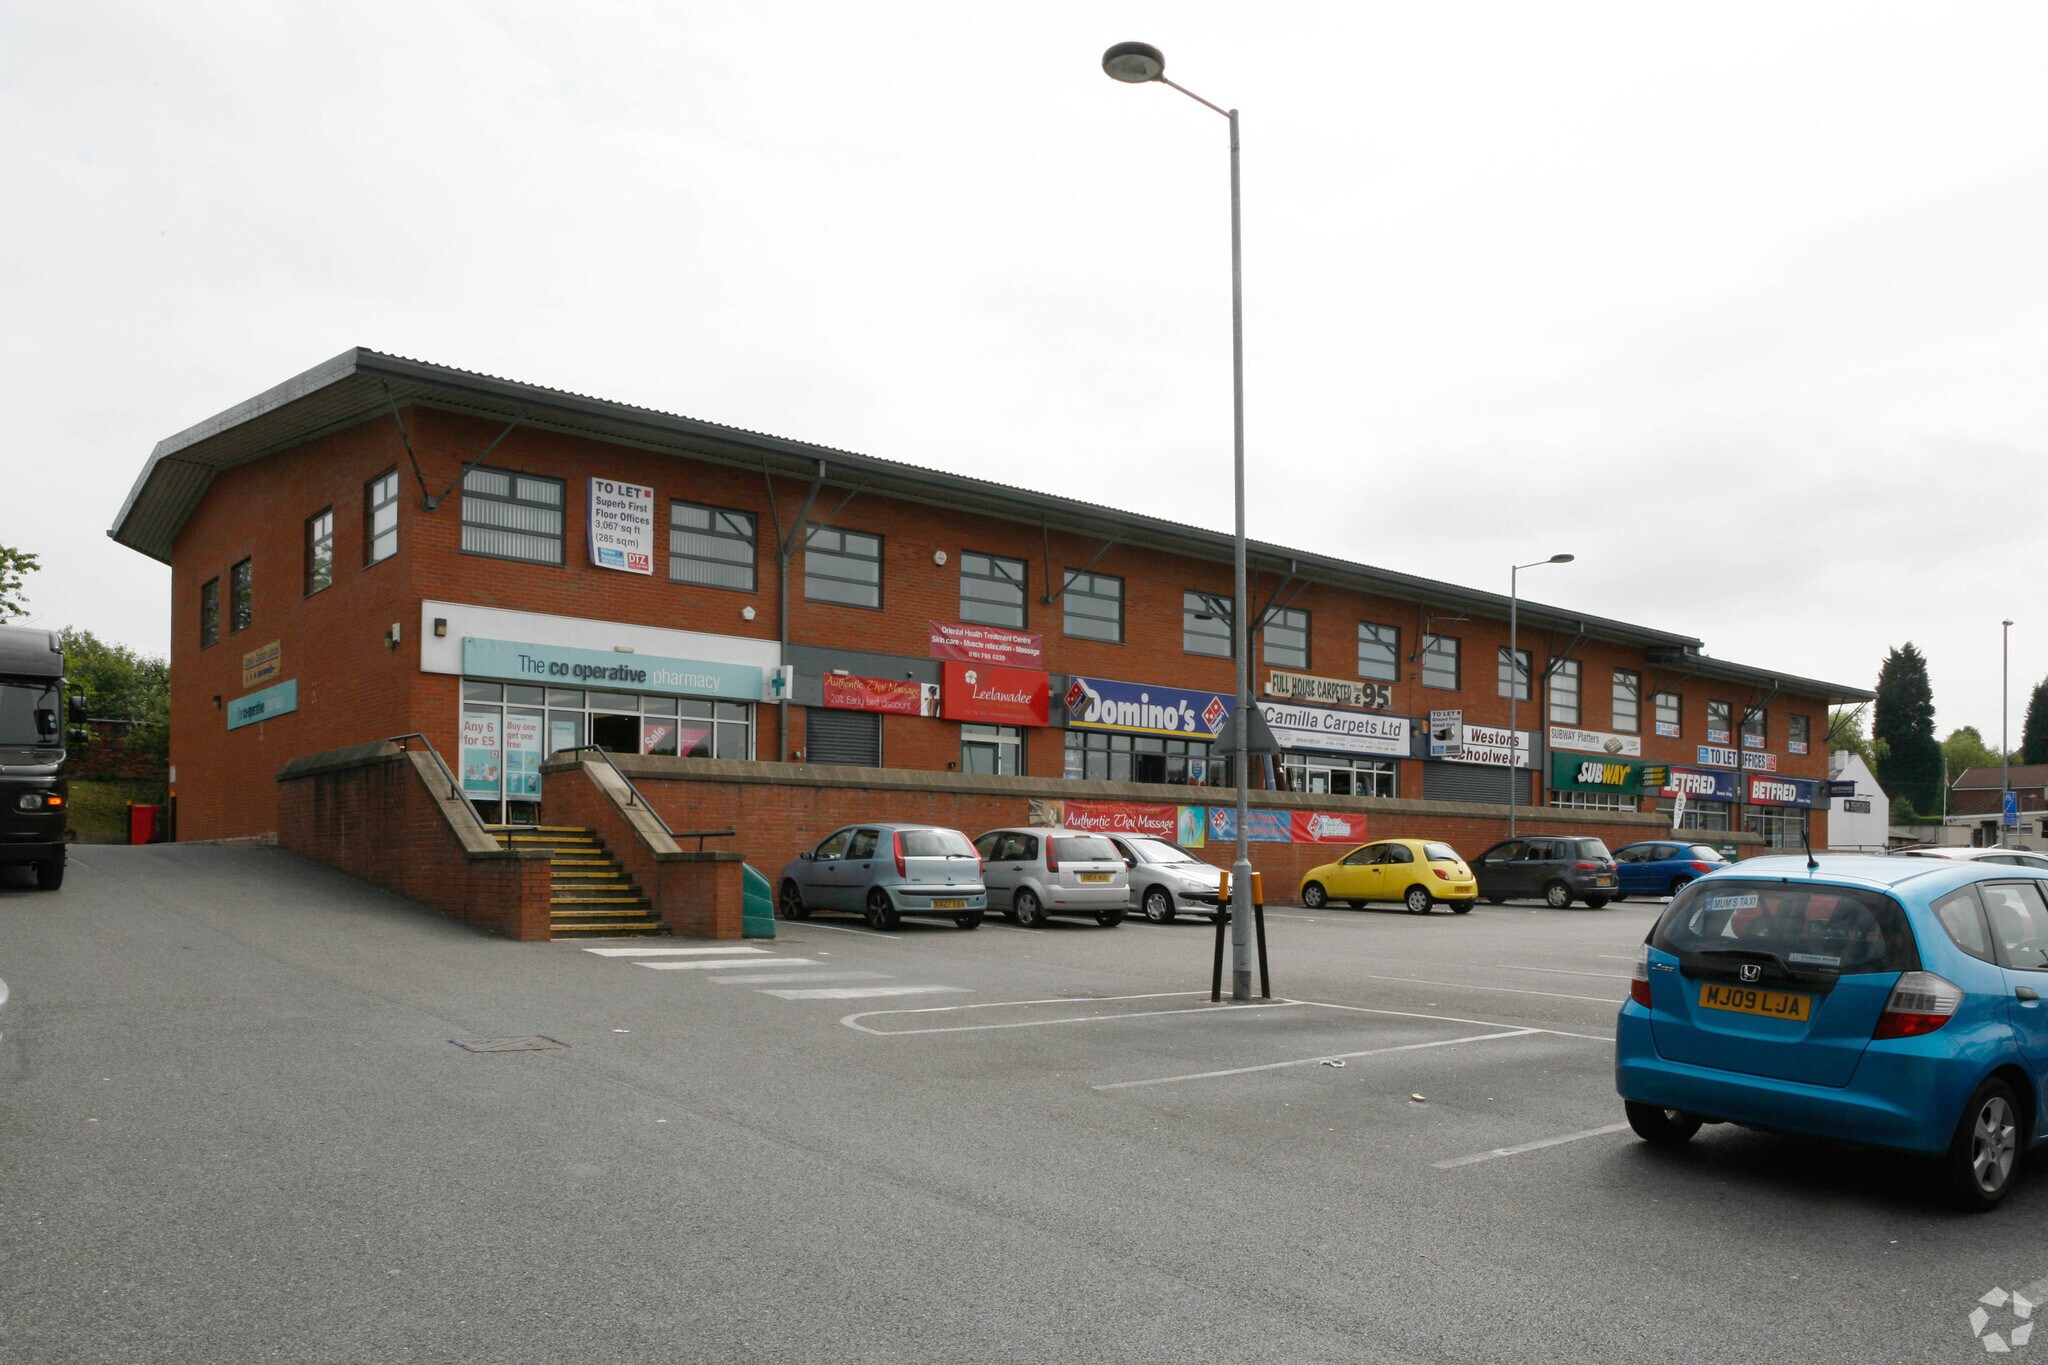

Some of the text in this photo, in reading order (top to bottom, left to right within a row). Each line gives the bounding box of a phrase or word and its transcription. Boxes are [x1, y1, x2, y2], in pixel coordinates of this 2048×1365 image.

[596, 481, 642, 498] TO LET
[596, 496, 647, 513] Superb First
[596, 508, 650, 525] Floor Offices
[595, 520, 641, 535] 3,067 sq ft
[596, 533, 614, 544] (285
[628, 553, 646, 565] DTZ
[941, 625, 1032, 645] Oriental Health Treatment Centre
[931, 635, 945, 643] Skin
[963, 639, 984, 649] Muscle
[984, 641, 1012, 651] relaxation
[1015, 646, 1040, 656] Massage
[518, 655, 721, 691] The co operative pharmacy
[825, 676, 920, 699] Authentic Thai Massage
[972, 683, 1032, 704] Leelawadee
[1272, 674, 1289, 694] FULL
[1291, 677, 1315, 698] HOUSE
[1317, 680, 1352, 700] CARPETED
[831, 694, 912, 710] 20% Early bird discount
[1076, 678, 1195, 732] Domino's
[464, 721, 494, 734] Any 6
[506, 722, 520, 732] Buy
[1264, 706, 1402, 737] Camilla Carpets Ltd
[464, 735, 495, 746] for £5
[506, 732, 519, 741] get
[506, 740, 521, 749] free
[644, 726, 666, 748] Sale
[1471, 728, 1519, 747] Westons
[1551, 728, 1599, 744] SUBWAY Platters
[1710, 748, 1721, 763] TO
[1723, 751, 1737, 766] LET
[1577, 762, 1631, 785] SUBWAY
[1752, 778, 1796, 801] BETFRED
[1082, 804, 1096, 814] Early
[1065, 811, 1174, 835] Authentic Thai Massage
[1713, 896, 1757, 909] MUM'S TAXI
[1707, 986, 1800, 1016] MJ09 LJA
